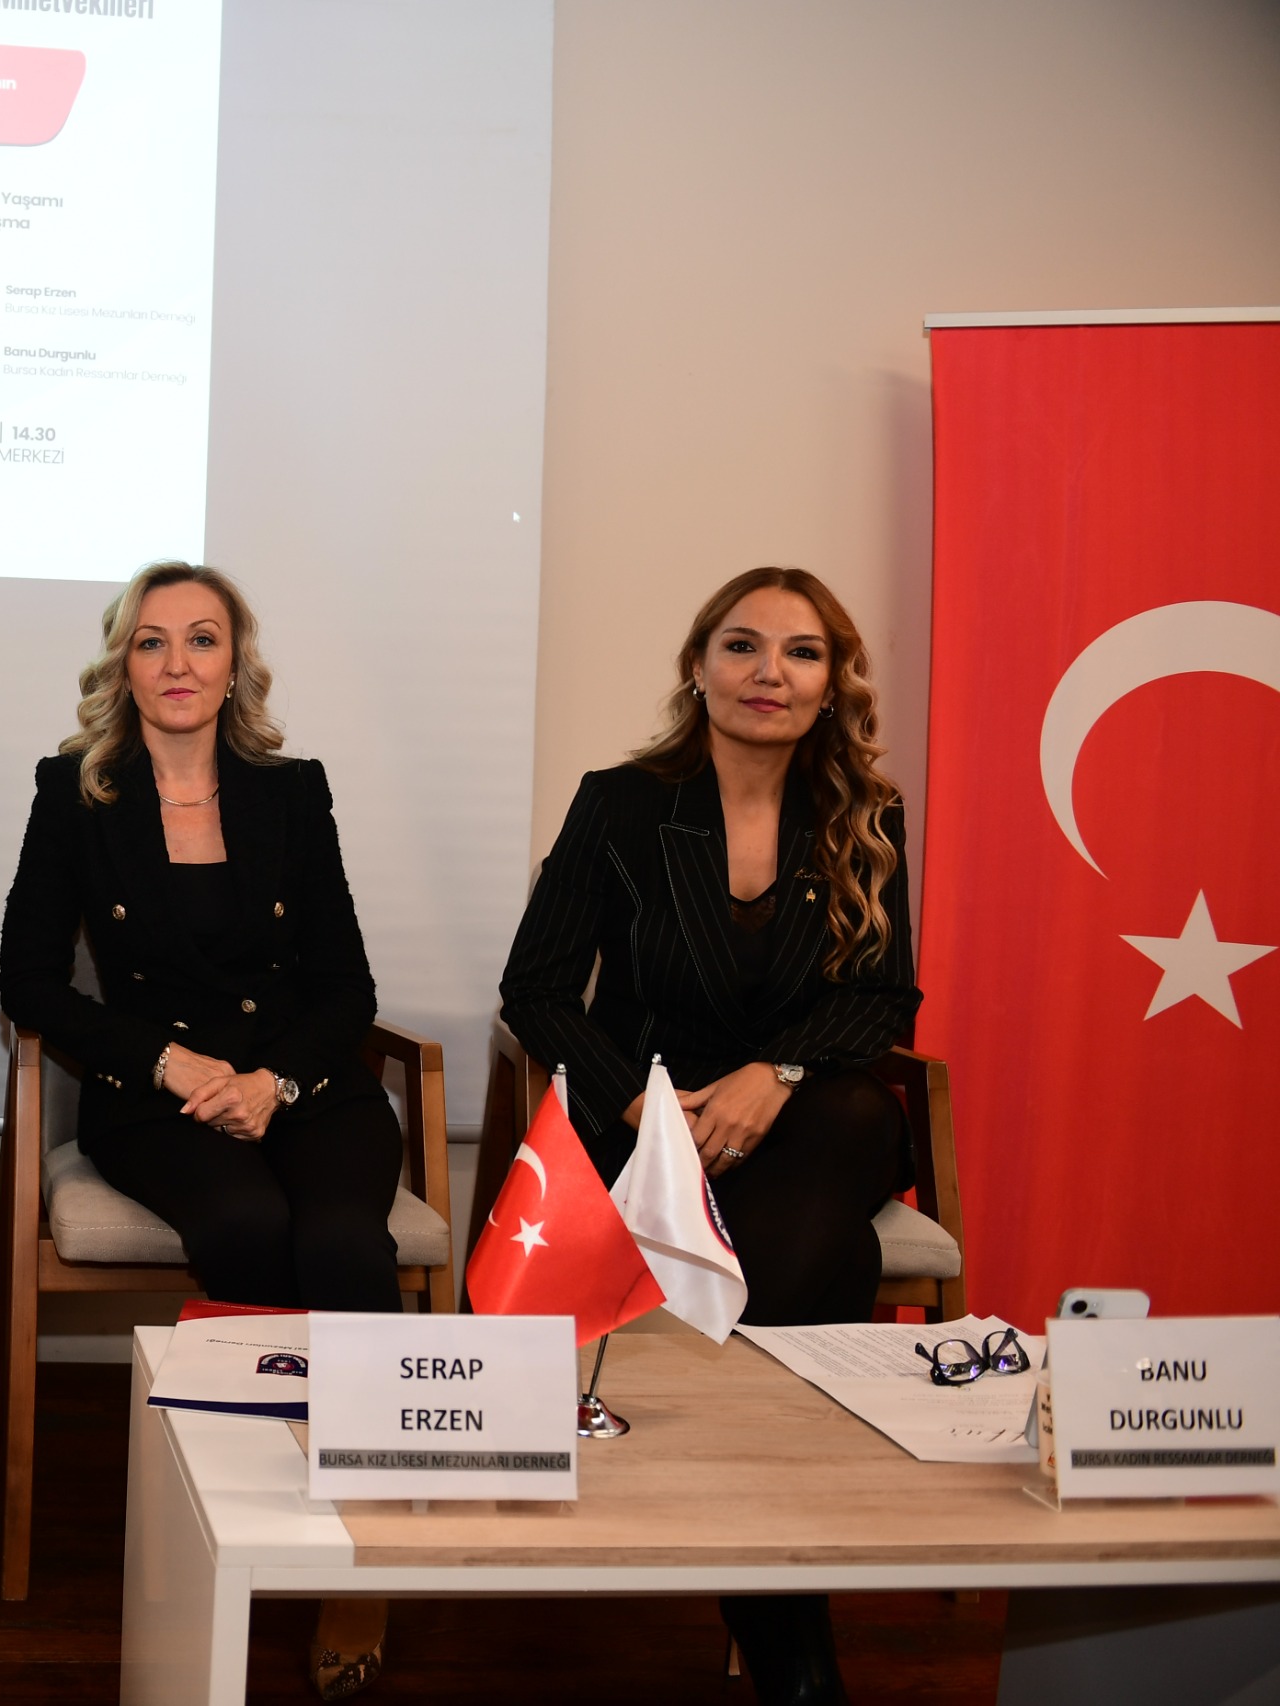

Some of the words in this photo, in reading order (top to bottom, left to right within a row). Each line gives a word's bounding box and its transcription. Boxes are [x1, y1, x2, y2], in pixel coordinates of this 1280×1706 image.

[1, 192, 64, 210] Yaşamı
[6, 285, 42, 299] Serap
[44, 287, 77, 298] Erzen
[4, 302, 39, 315] Bursa
[4, 346, 36, 358] Banu
[38, 348, 96, 362] Durgunlu
[3, 364, 37, 376] Bursa
[76, 368, 138, 381] Ressamlar
[12, 426, 56, 441] 14.30
[399, 1356, 484, 1380] SERAP
[1140, 1360, 1207, 1382] BANU
[400, 1408, 484, 1432] ERZEN
[1110, 1408, 1243, 1431] DURGUNLU
[320, 1453, 363, 1466] BURSA
[367, 1454, 387, 1466] KIZ
[391, 1452, 428, 1467] LİSESİ
[432, 1454, 509, 1468] MEZUNLARI
[513, 1452, 570, 1469] DERNEĞİ
[1072, 1453, 1111, 1466] BURSA
[1114, 1452, 1150, 1466] KADIN
